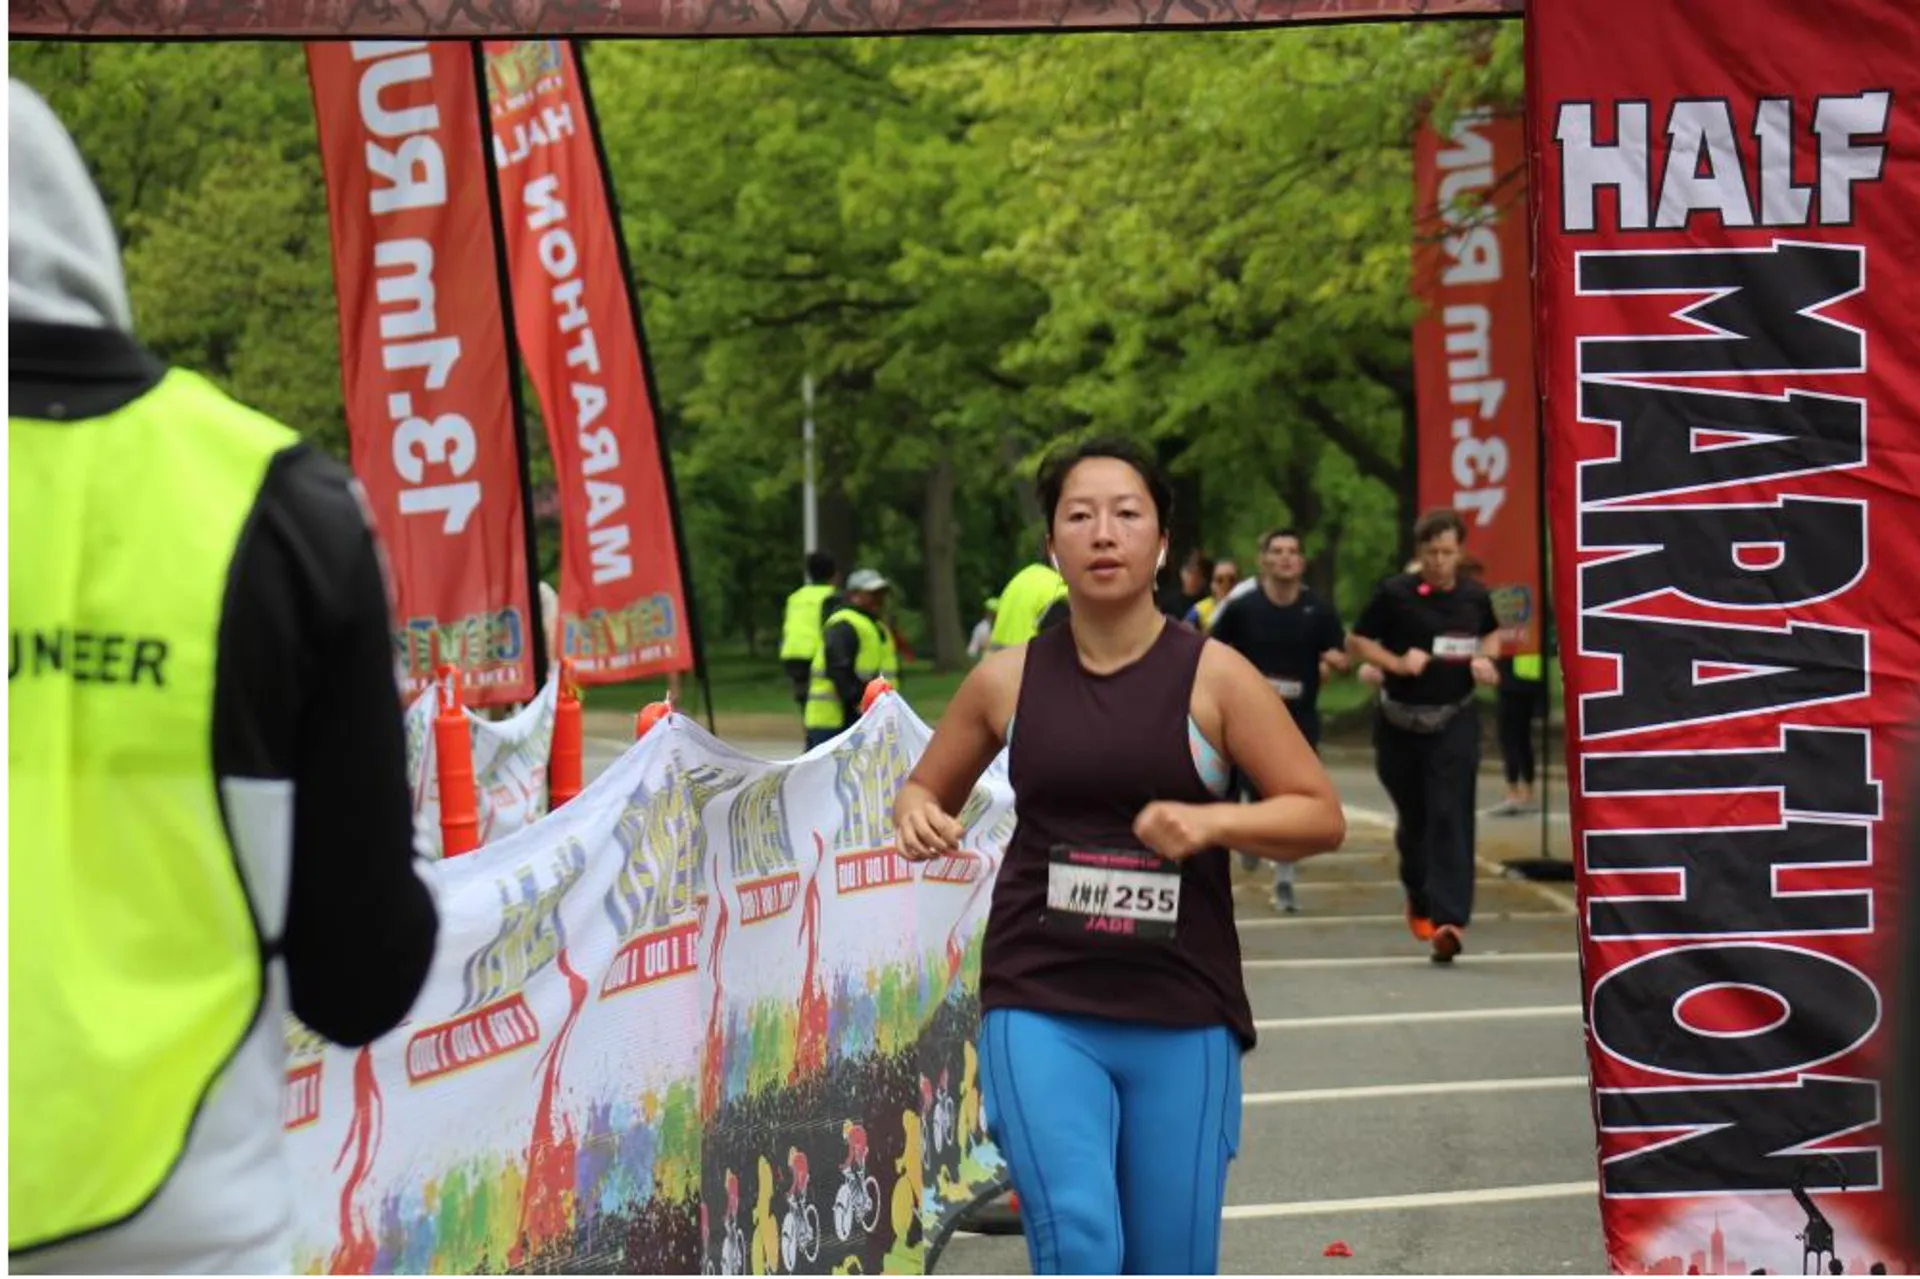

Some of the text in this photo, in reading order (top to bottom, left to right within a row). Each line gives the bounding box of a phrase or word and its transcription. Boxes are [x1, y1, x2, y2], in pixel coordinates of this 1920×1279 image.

[1554, 89, 1893, 232] HALF
[1574, 237, 1884, 1200] MARATHON
[1113, 884, 1175, 913] 255
